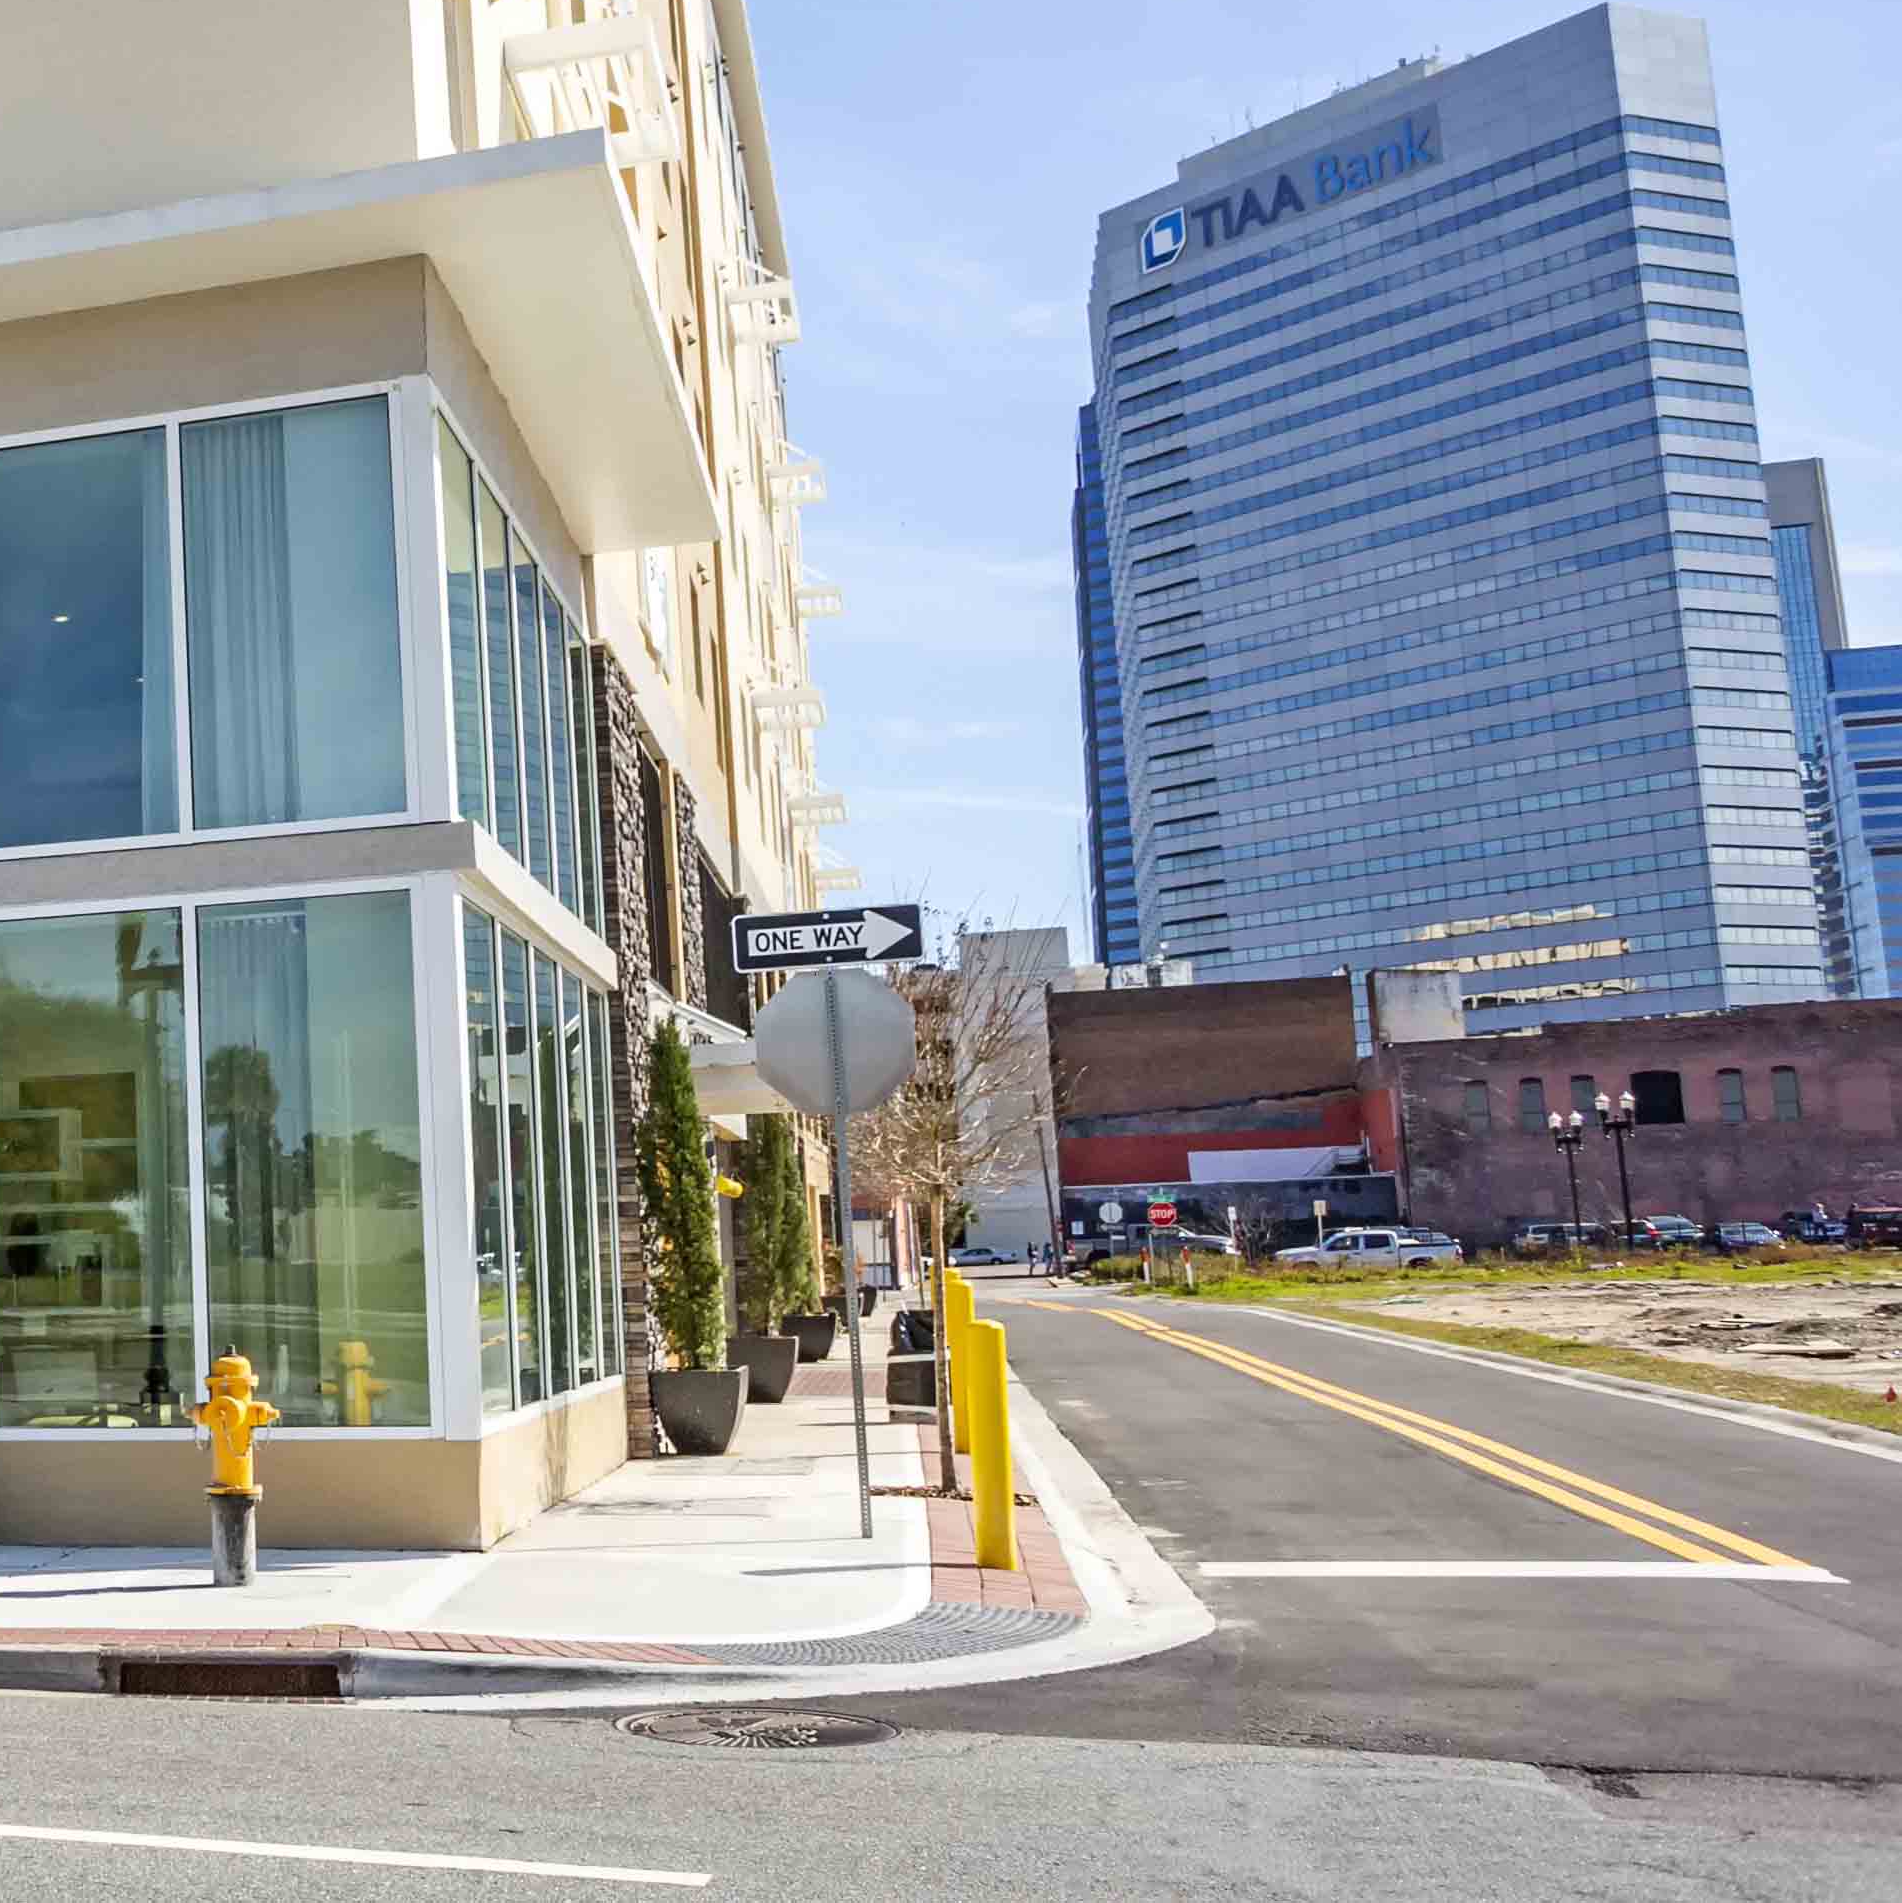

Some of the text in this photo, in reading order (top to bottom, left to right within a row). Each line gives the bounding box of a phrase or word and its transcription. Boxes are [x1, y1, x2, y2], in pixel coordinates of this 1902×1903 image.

[1191, 117, 1433, 247] TIAA Bank
[755, 924, 864, 952] ONE WAY
[1150, 1209, 1173, 1218] STOP
